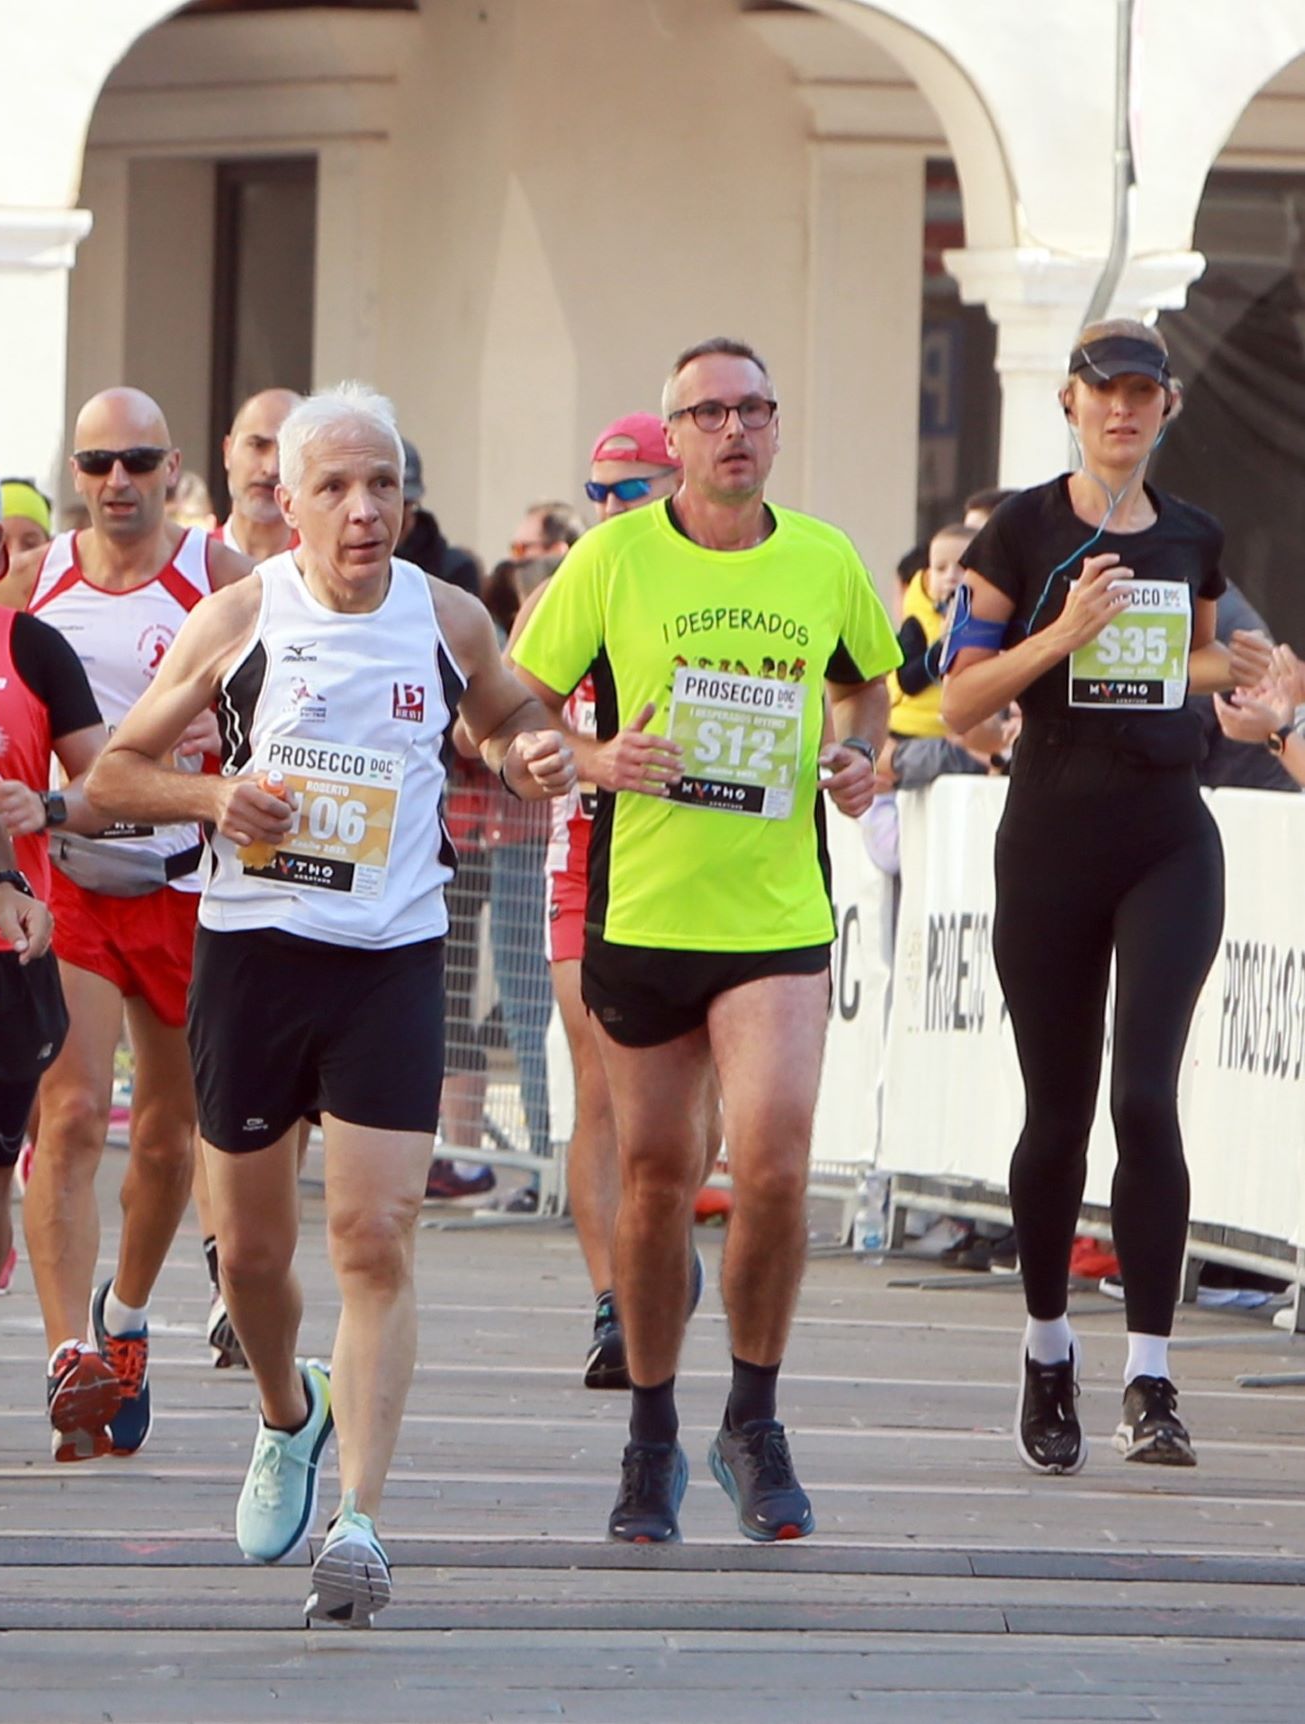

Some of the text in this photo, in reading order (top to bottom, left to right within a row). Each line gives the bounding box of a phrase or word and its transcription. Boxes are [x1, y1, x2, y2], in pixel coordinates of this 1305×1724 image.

[675, 608, 809, 647] DESPERADOS
[1096, 624, 1168, 665] S35
[684, 676, 775, 707] PROSECCO
[268, 743, 394, 776] PROSECCO DOC
[694, 720, 776, 770] S12
[306, 780, 350, 797] ROBERTO
[682, 782, 746, 801] MYTHO
